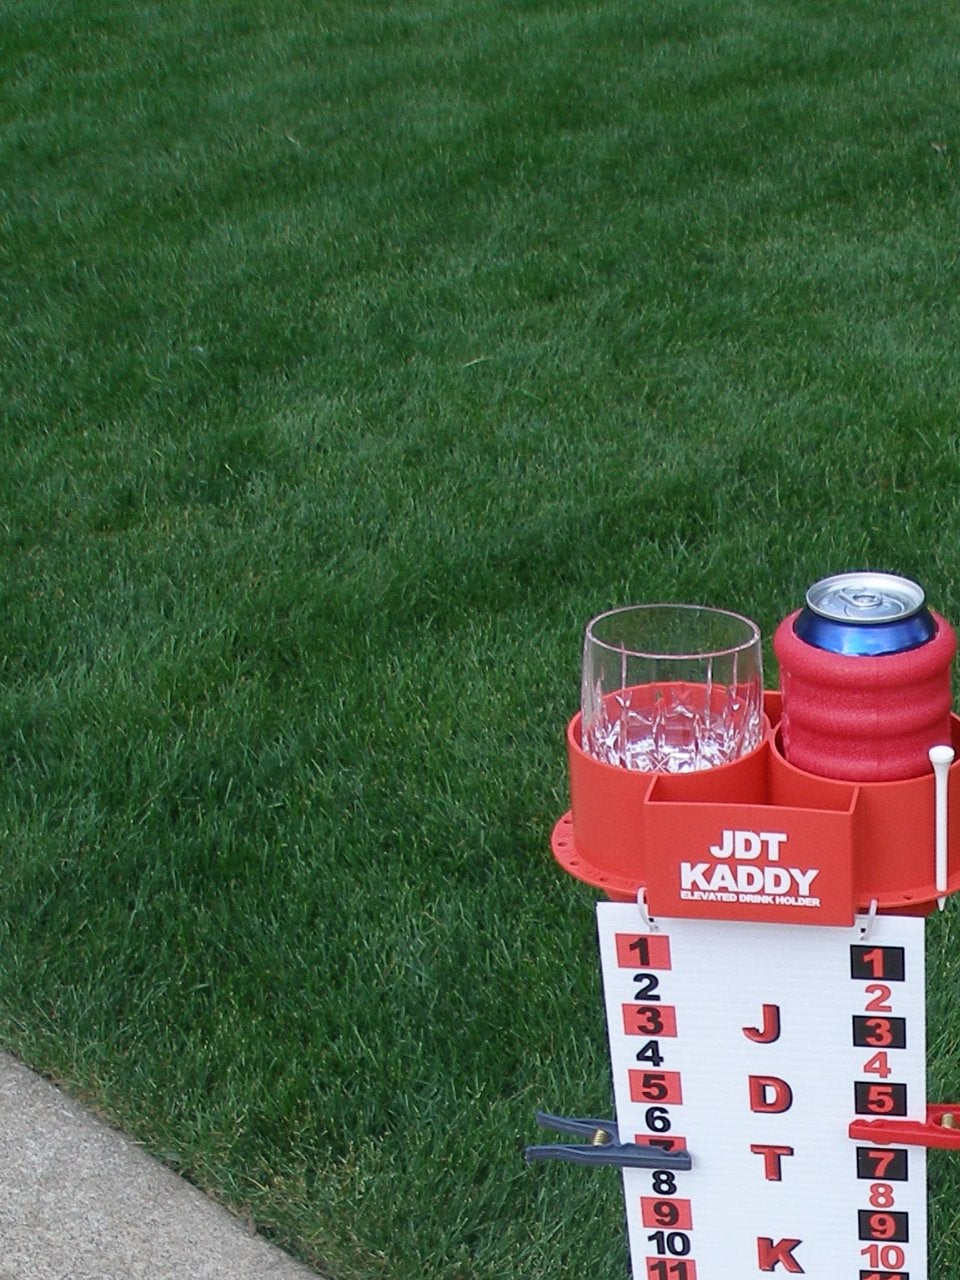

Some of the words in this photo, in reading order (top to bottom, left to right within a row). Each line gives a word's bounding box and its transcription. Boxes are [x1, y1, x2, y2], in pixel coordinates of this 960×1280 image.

[709, 830, 787, 861] JDT
[680, 862, 819, 896] KADDY
[681, 891, 738, 902] ELEVATED
[739, 893, 774, 905] DRINK
[775, 896, 821, 907] HOLDER
[628, 937, 649, 966] 1
[862, 949, 884, 977] 1
[632, 972, 661, 1001] 2
[864, 984, 892, 1012] 2
[636, 1007, 663, 1035] 3
[866, 1018, 892, 1045] 3
[636, 1041, 664, 1067] 4
[863, 1051, 891, 1078] 4
[641, 1075, 668, 1100] 5
[867, 1086, 894, 1113] 5
[645, 1107, 671, 1132] 6
[868, 1151, 895, 1177] 7
[652, 1170, 678, 1196] 8
[869, 1183, 895, 1207] 8
[652, 1201, 679, 1226] 9
[870, 1213, 896, 1239] 9
[647, 1230, 691, 1256] 10
[860, 1244, 905, 1270] 10
